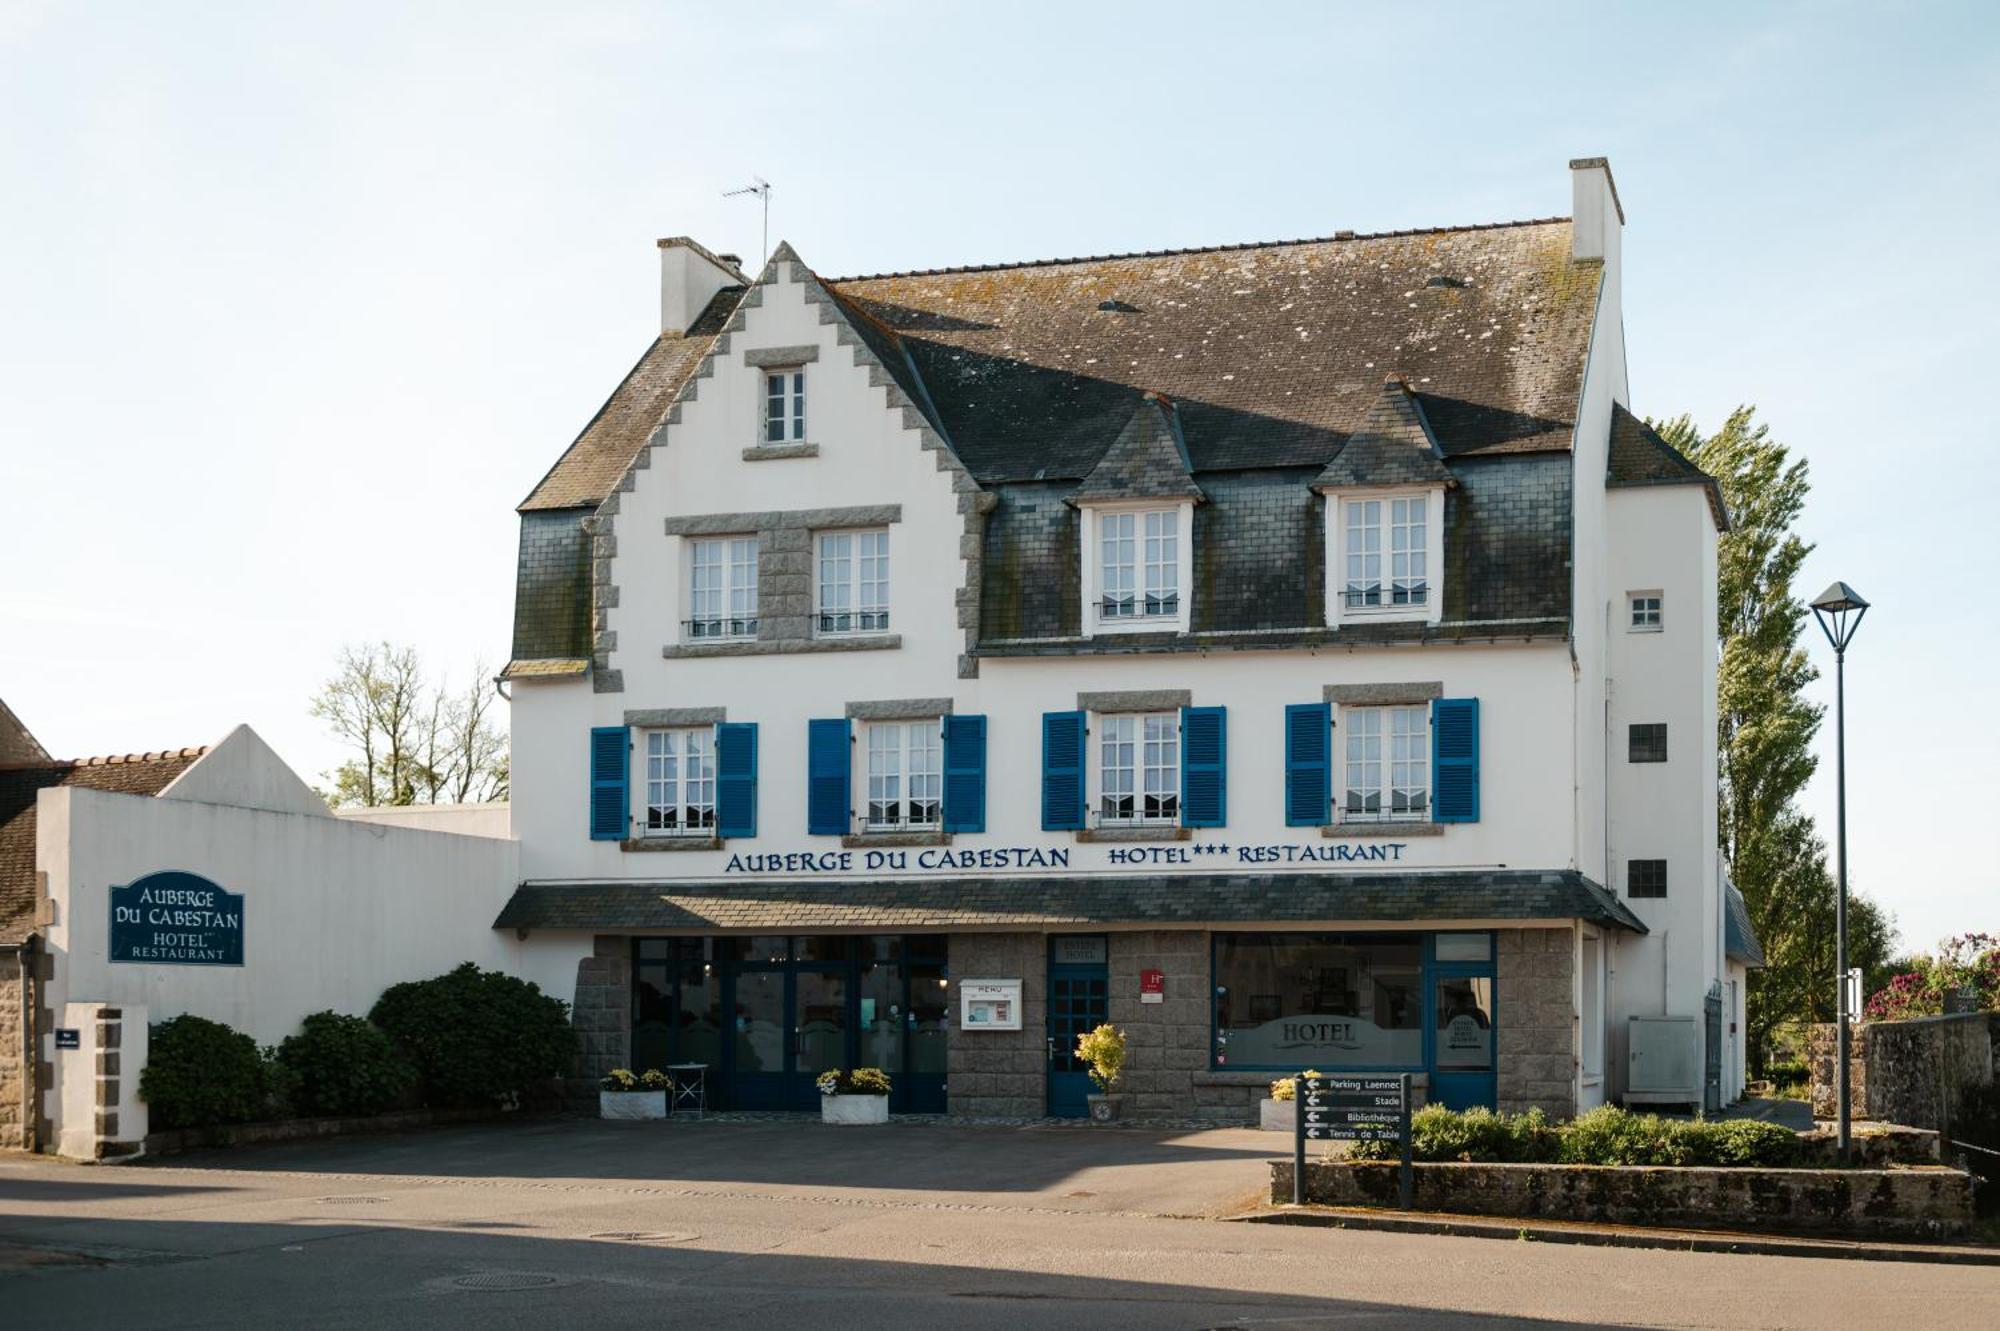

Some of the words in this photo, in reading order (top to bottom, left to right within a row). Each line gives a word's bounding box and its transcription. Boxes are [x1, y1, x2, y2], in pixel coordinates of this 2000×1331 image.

[725, 850, 853, 873] AUBERGE
[866, 850, 907, 870] DU
[918, 847, 1070, 869] CABESTAN
[1108, 847, 1192, 864] HOTEL
[1237, 843, 1407, 863] RESTAURANT
[140, 887, 214, 908] AUBERGE
[116, 906, 141, 924] DU
[148, 908, 239, 929] CABESTAN
[153, 932, 208, 948] HOTEL
[132, 946, 225, 960] RESTAURANT
[1283, 1022, 1356, 1042] HOTEL
[1330, 1079, 1360, 1091] Parking
[1365, 1080, 1400, 1090] Laennec
[1375, 1097, 1400, 1106] Stade
[1330, 1129, 1356, 1139] Tennis
[1360, 1129, 1372, 1139] de
[1377, 1129, 1400, 1140] Table
